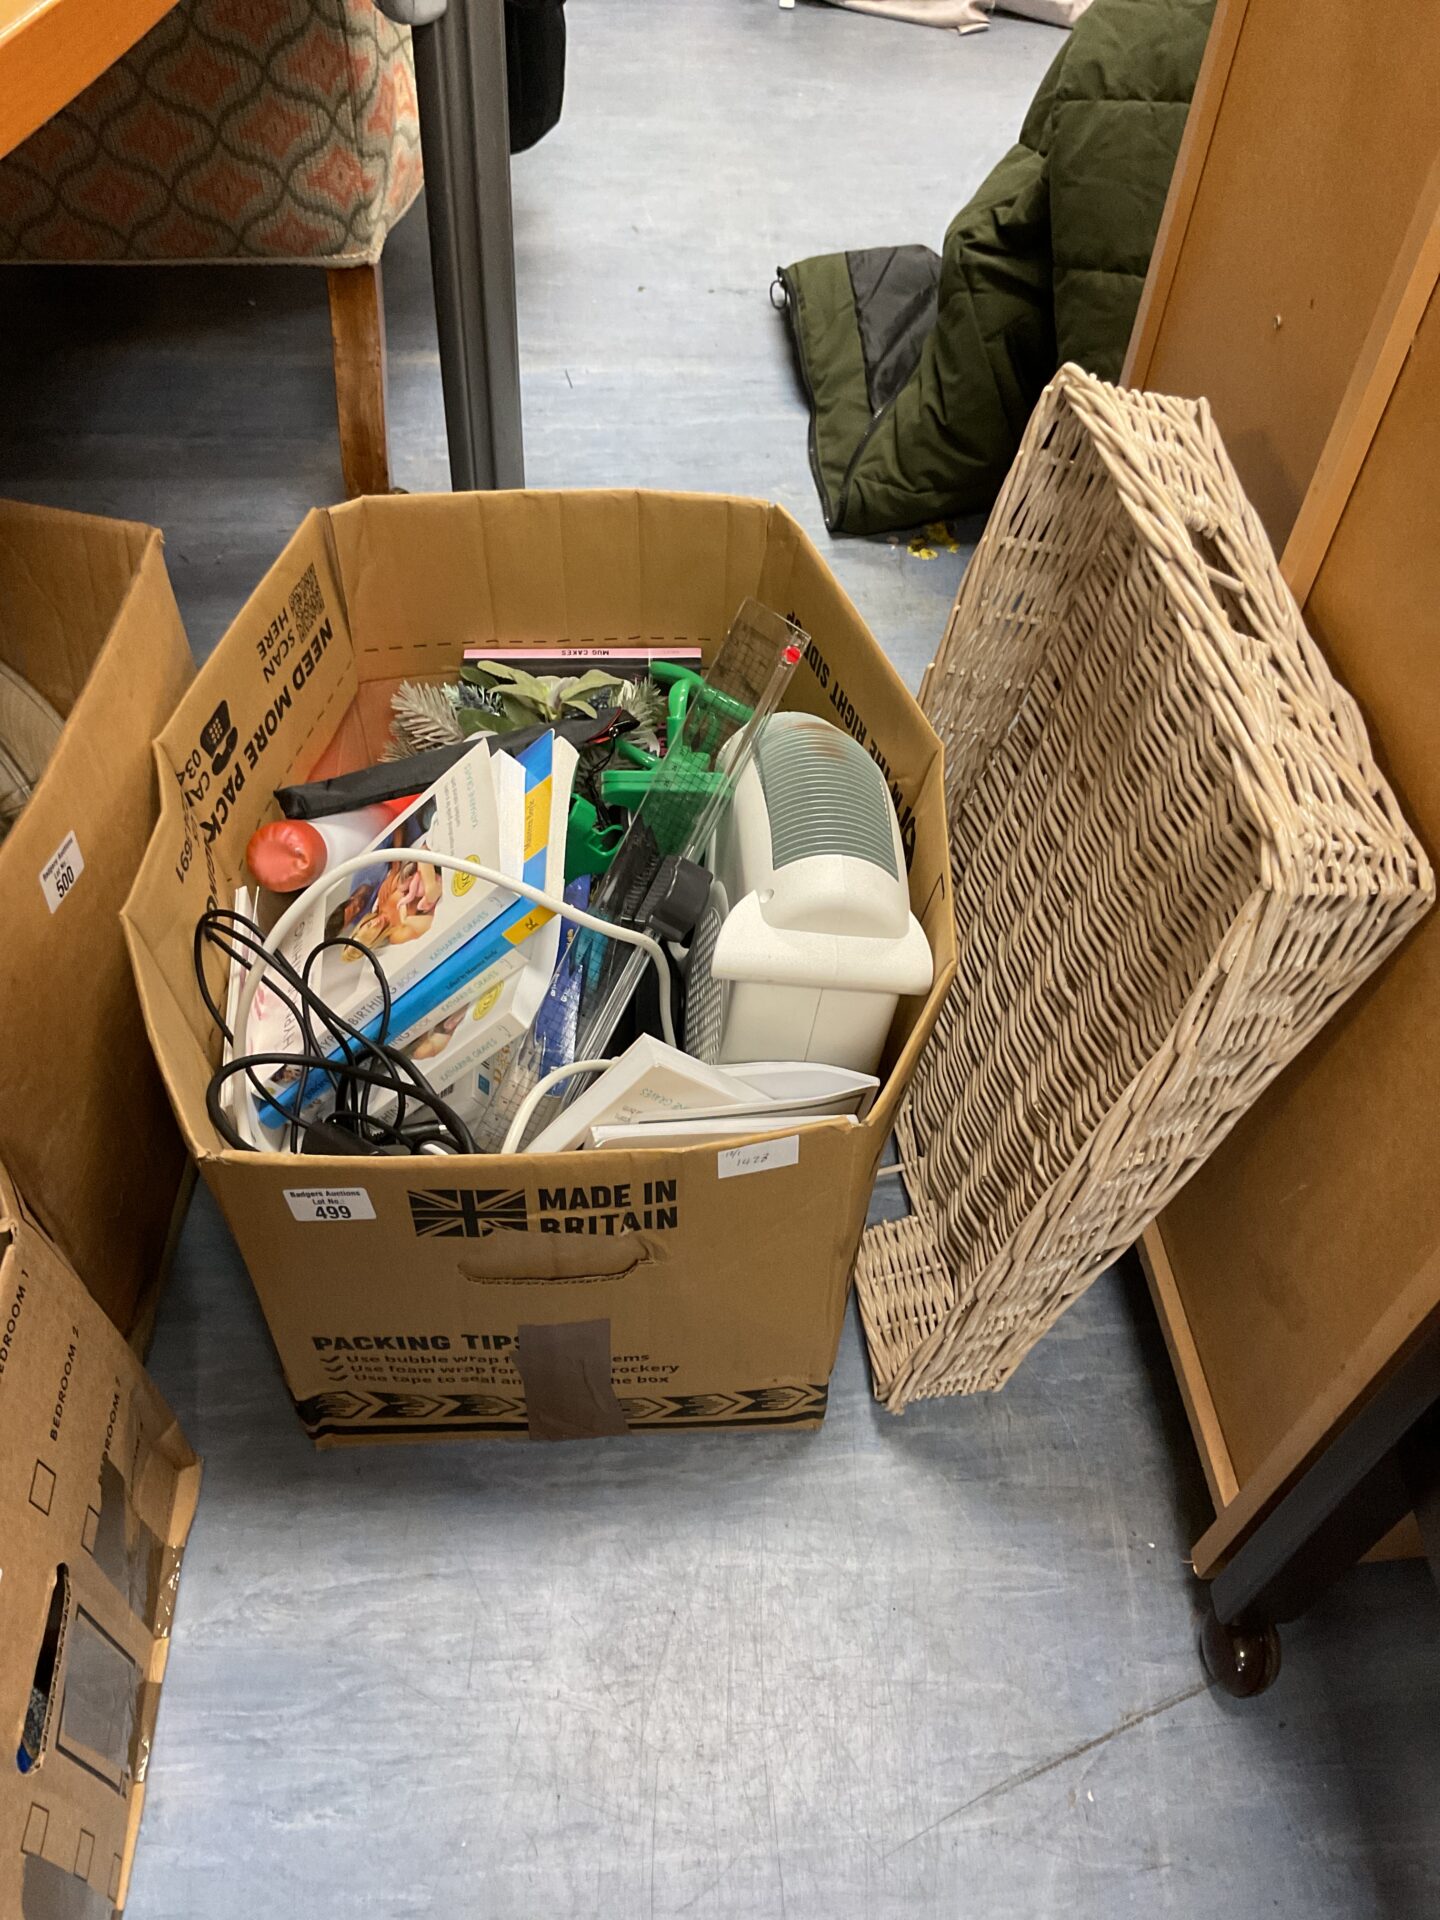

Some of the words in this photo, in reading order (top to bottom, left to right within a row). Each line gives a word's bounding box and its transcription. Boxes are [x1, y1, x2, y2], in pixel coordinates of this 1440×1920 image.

[256, 607, 289, 660] HERE
[263, 629, 295, 683] SCAN
[292, 617, 333, 691] NEED
[243, 685, 292, 769] MORE
[829, 681, 867, 747] RIGHT
[56, 866, 75, 898] 500
[430, 934, 466, 961] KATHARINE
[463, 911, 489, 934] GRAVES
[471, 1038, 498, 1061] GRAVES
[290, 1191, 323, 1199] Badgers
[538, 1183, 631, 1210] MADE
[644, 1179, 677, 1205] IN
[315, 1205, 352, 1219] 499
[540, 1206, 678, 1236] BRITAIN
[0, 1285, 27, 1378] EDROOM
[21, 1268, 30, 1279] 1
[312, 1336, 450, 1350] PACKING
[346, 1355, 380, 1364] Use
[385, 1355, 449, 1364] bubble
[453, 1356, 499, 1366] wrap
[351, 1365, 384, 1374] Use
[389, 1365, 435, 1374] foam
[440, 1366, 486, 1375] wrap
[490, 1366, 518, 1374] for
[611, 1364, 680, 1374] rockery
[50, 1343, 77, 1442] BEDROOM
[72, 1325, 80, 1339] 2
[354, 1374, 383, 1383] Use
[392, 1375, 433, 1385] tape
[437, 1375, 457, 1384] to
[461, 1375, 497, 1384] seal
[501, 1378, 522, 1386] an
[637, 1375, 669, 1384] box
